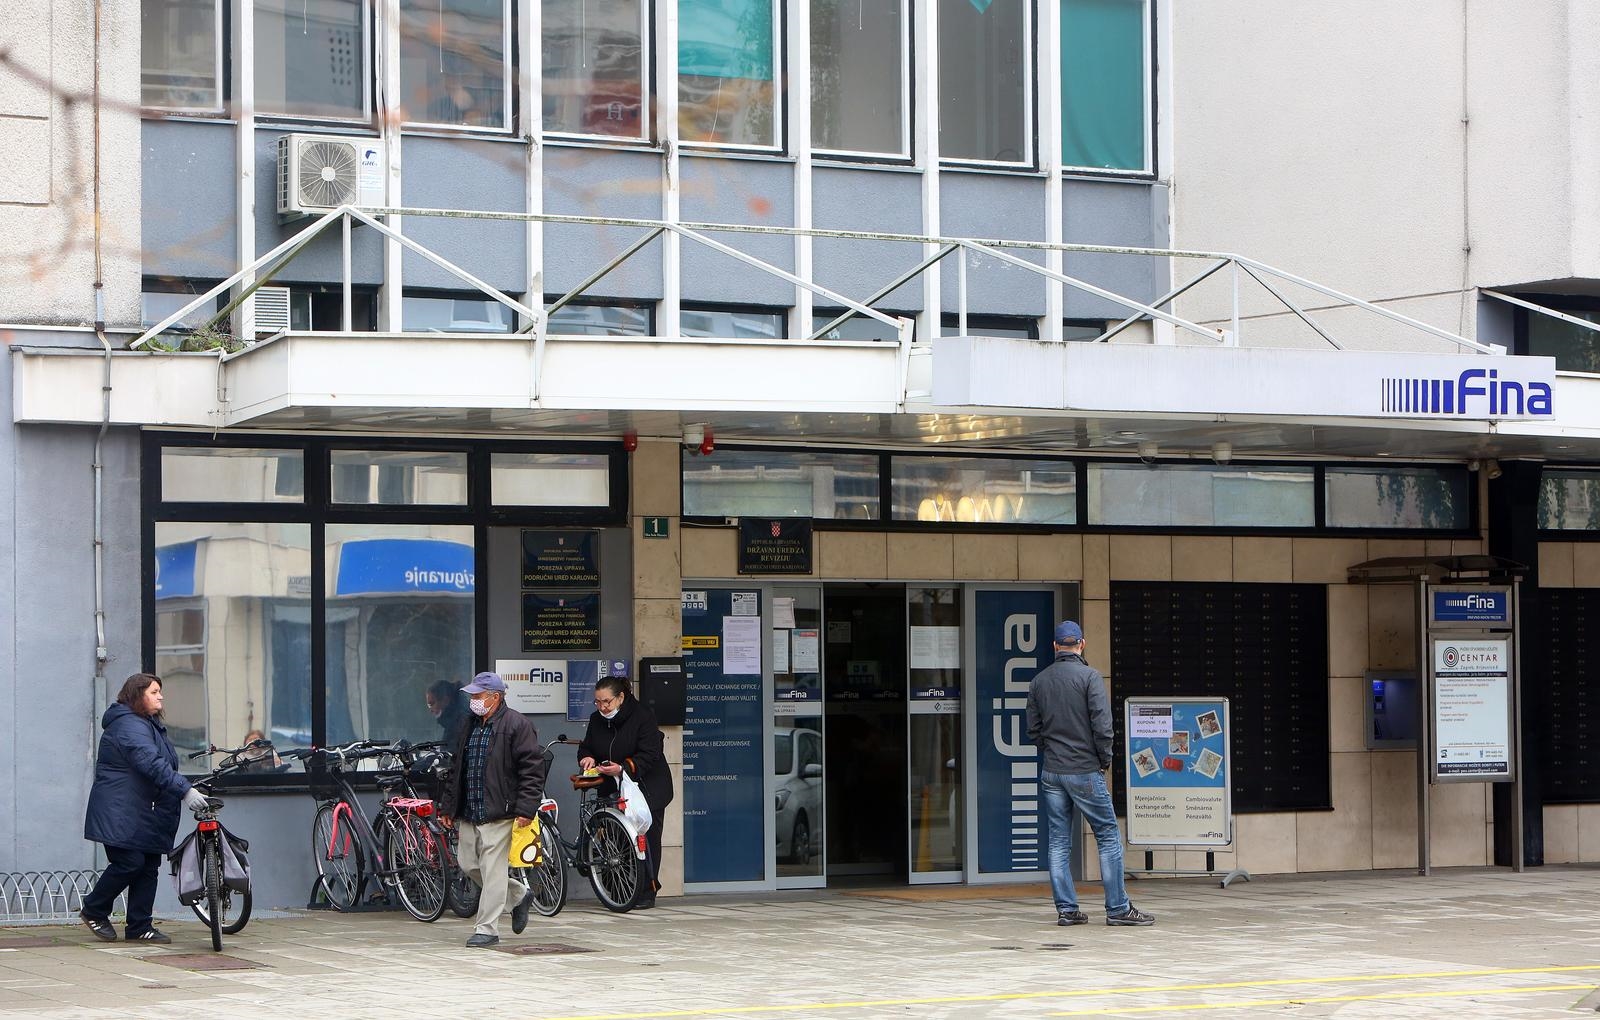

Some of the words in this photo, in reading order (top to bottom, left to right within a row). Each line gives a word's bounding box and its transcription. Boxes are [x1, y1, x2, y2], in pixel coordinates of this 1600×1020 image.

[1458, 368, 1553, 415] Fina
[651, 518, 658, 533] 1
[746, 546, 775, 554] DRŽAVNI
[524, 573, 554, 581] PODRUČNI
[1466, 594, 1495, 609] Fina
[1460, 654, 1498, 662] CENTAR
[529, 668, 563, 683] Fina
[992, 613, 1038, 757] Fina
[790, 690, 807, 699] Fina
[928, 688, 945, 697] Fina
[1134, 795, 1166, 803] Mjenjačnica
[1134, 803, 1160, 811] Exchange
[1207, 831, 1223, 839] Fina
